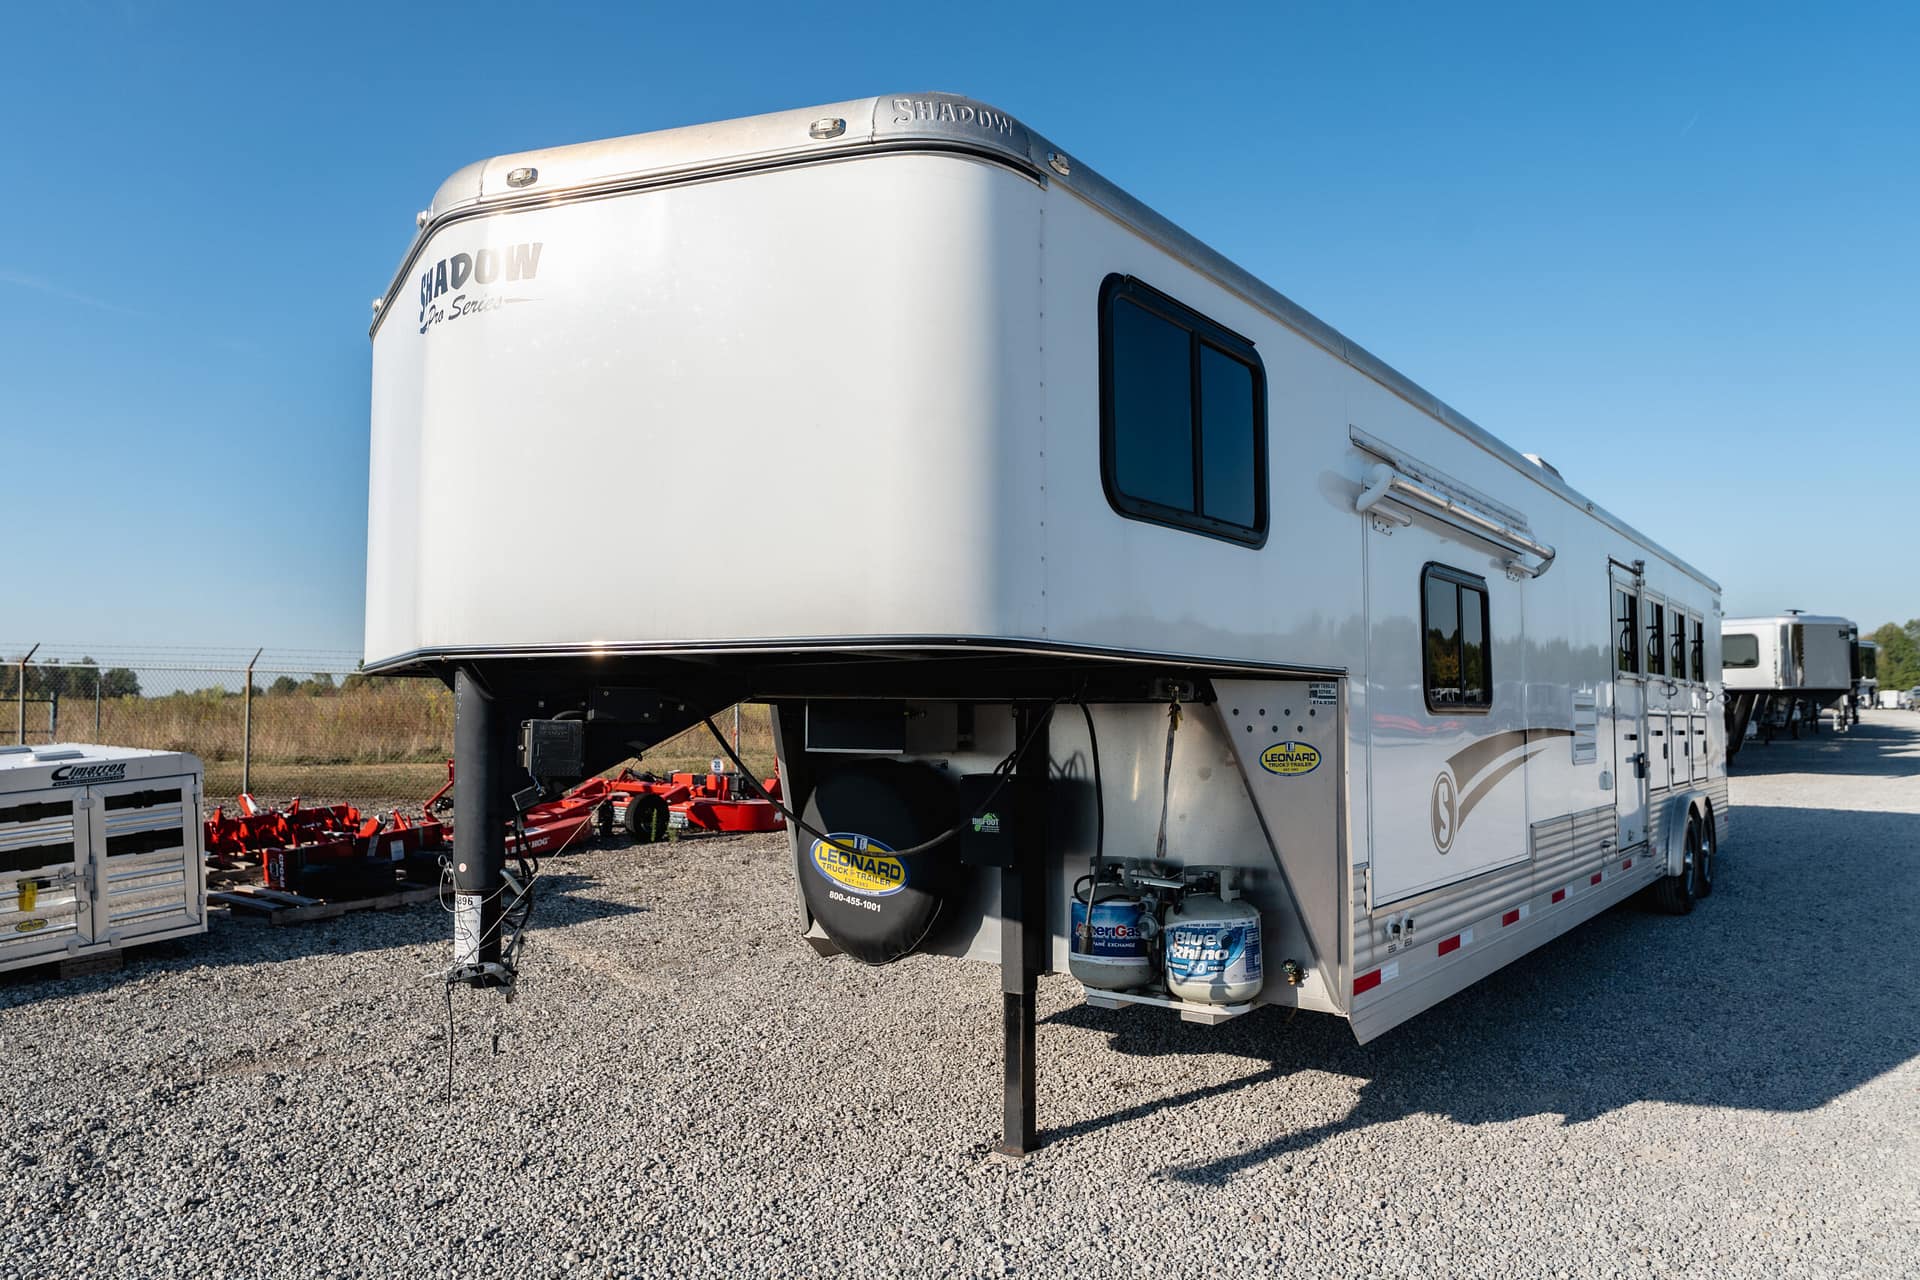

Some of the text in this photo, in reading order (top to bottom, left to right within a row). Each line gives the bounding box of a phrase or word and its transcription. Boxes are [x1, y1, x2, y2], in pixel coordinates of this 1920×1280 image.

[892, 98, 1014, 137] SHADOW
[419, 242, 543, 323] SHADOW
[1265, 752, 1317, 763] LEONARD
[51, 763, 127, 781] Cimarron
[818, 846, 902, 881] LEONARD
[822, 861, 849, 876] TRUCK
[855, 871, 892, 887] TRAILER
[828, 890, 882, 913] 800-455-1001
[1174, 931, 1217, 947] Blue
[1171, 945, 1230, 961] Rhino
